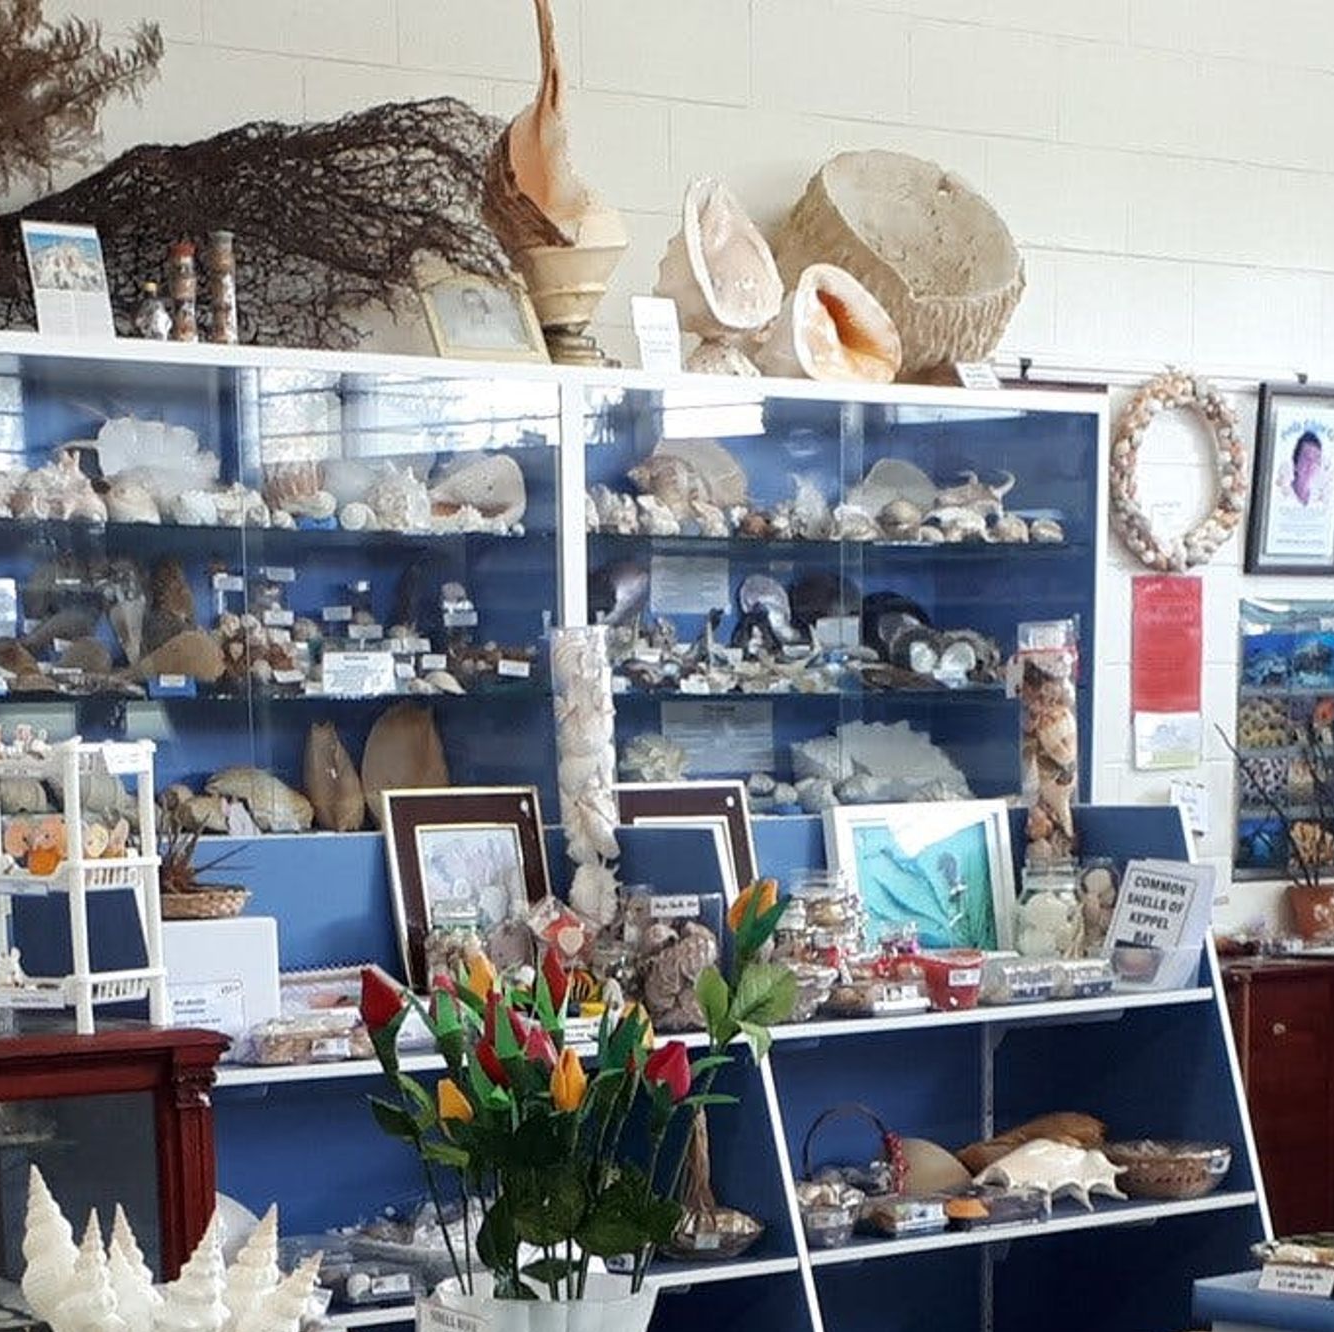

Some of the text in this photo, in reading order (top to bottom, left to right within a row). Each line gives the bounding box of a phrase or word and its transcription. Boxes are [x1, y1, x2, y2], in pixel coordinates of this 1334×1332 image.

[1134, 876, 1187, 896] COMMON
[1128, 893, 1185, 914] SHELLS OF
[1130, 912, 1169, 930] KEPPEL
